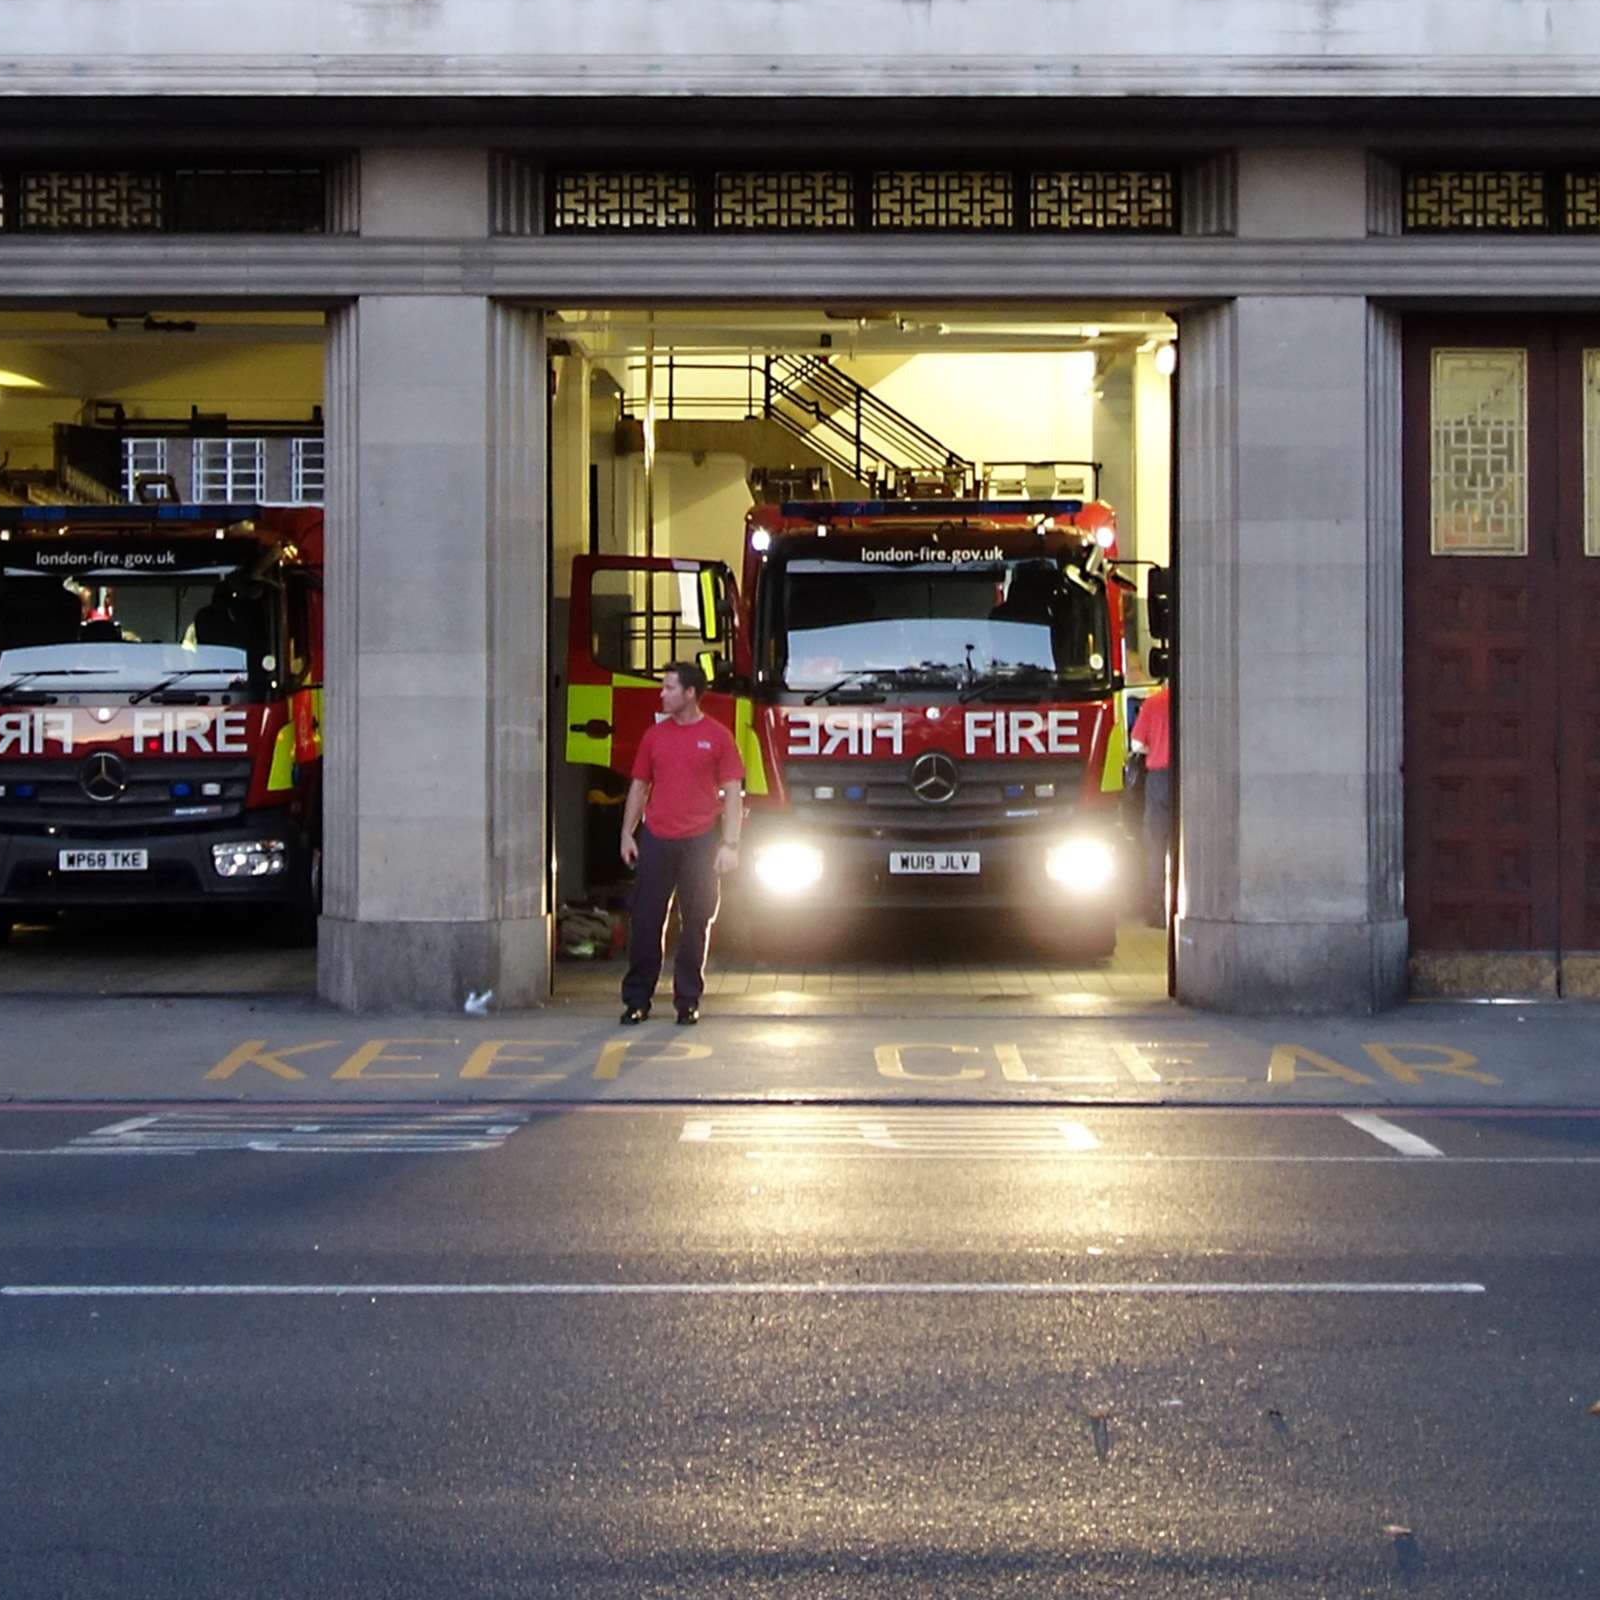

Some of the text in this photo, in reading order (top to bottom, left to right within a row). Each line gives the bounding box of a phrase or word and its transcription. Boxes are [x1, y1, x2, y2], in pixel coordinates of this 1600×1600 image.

[36, 551, 175, 568] london-fire.gov.uk
[860, 545, 1004, 564] london-fire.gov.uk
[132, 710, 249, 754] FIRE
[963, 710, 1081, 755] FIRE
[112, 851, 142, 868] TKE
[940, 854, 970, 870] JLV
[205, 1038, 1503, 1086] KEEP CLEAR
